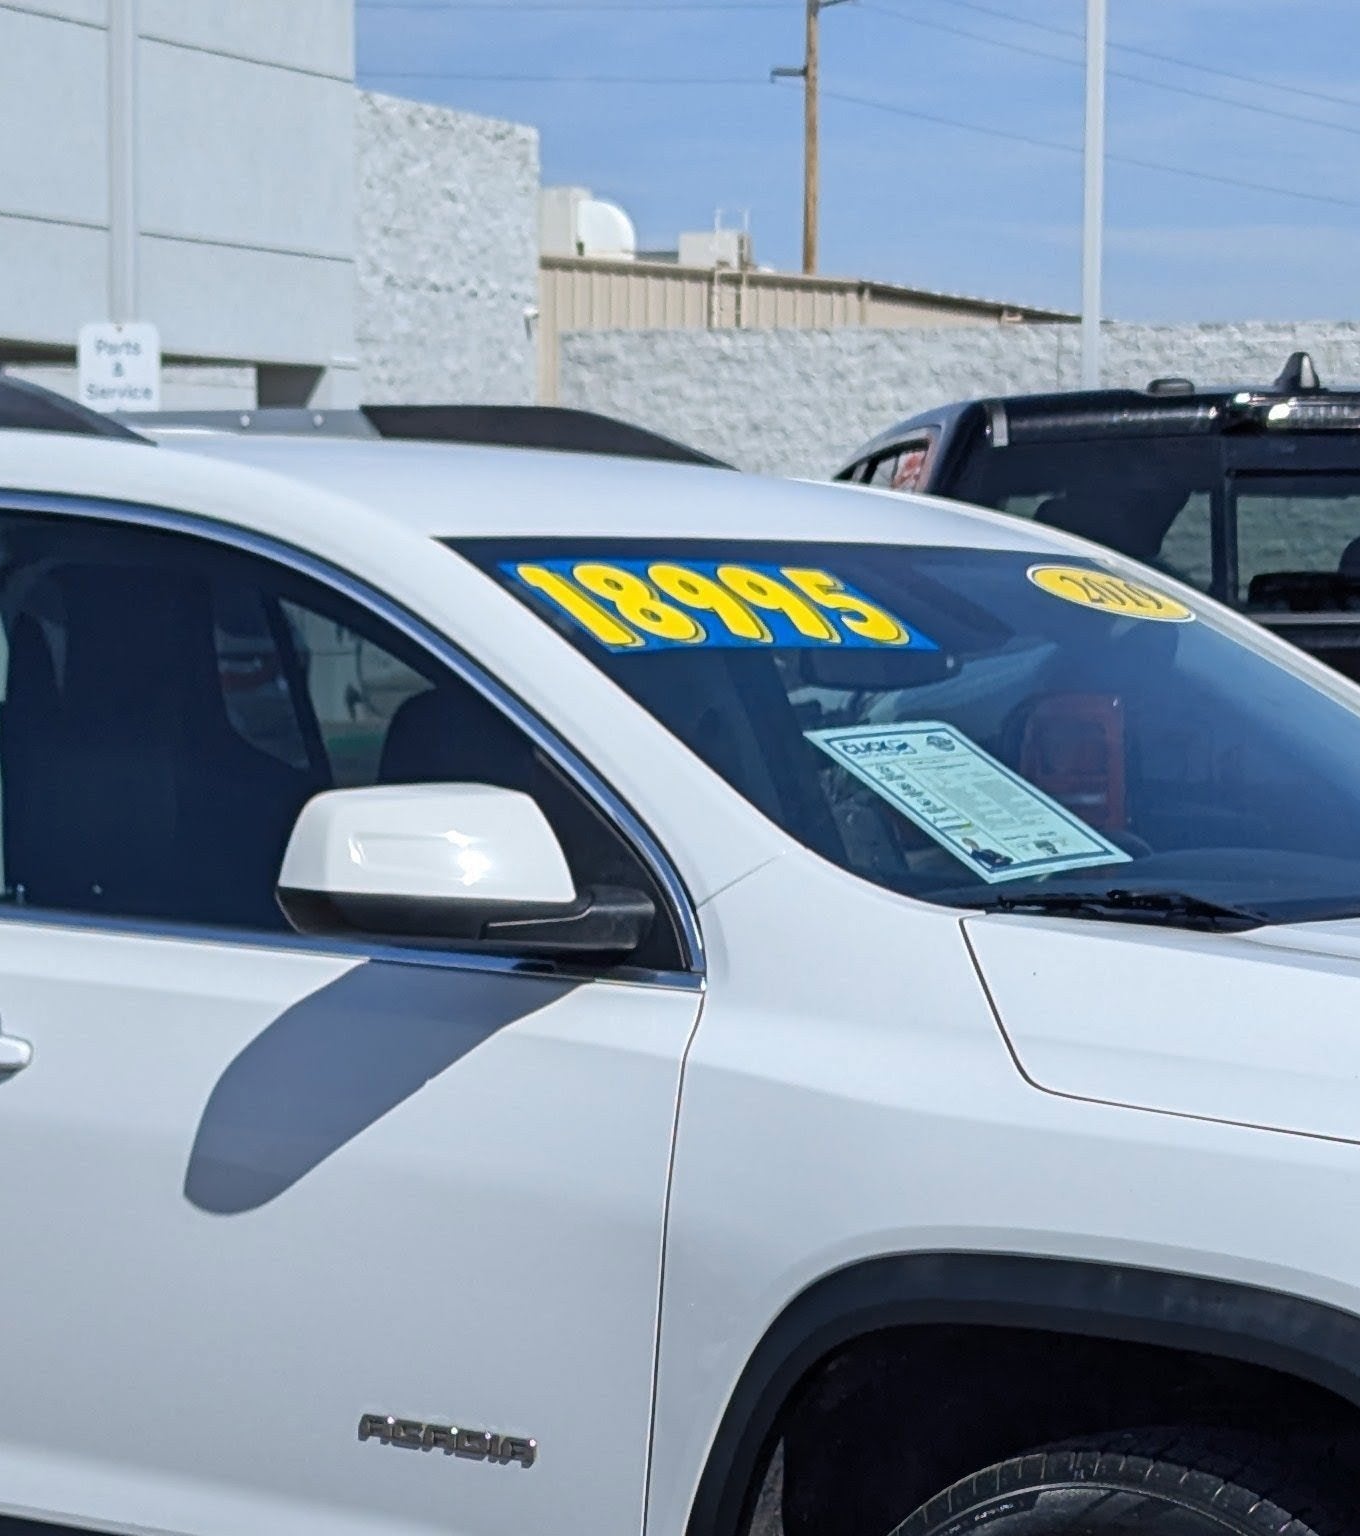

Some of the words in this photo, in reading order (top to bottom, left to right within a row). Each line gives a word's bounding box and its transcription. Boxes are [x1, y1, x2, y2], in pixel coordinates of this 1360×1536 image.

[94, 337, 142, 357] Parts
[86, 383, 154, 400] Service
[516, 563, 910, 648] 18995
[1059, 575, 1163, 610] 2019
[357, 1412, 538, 1470] ACADIA
